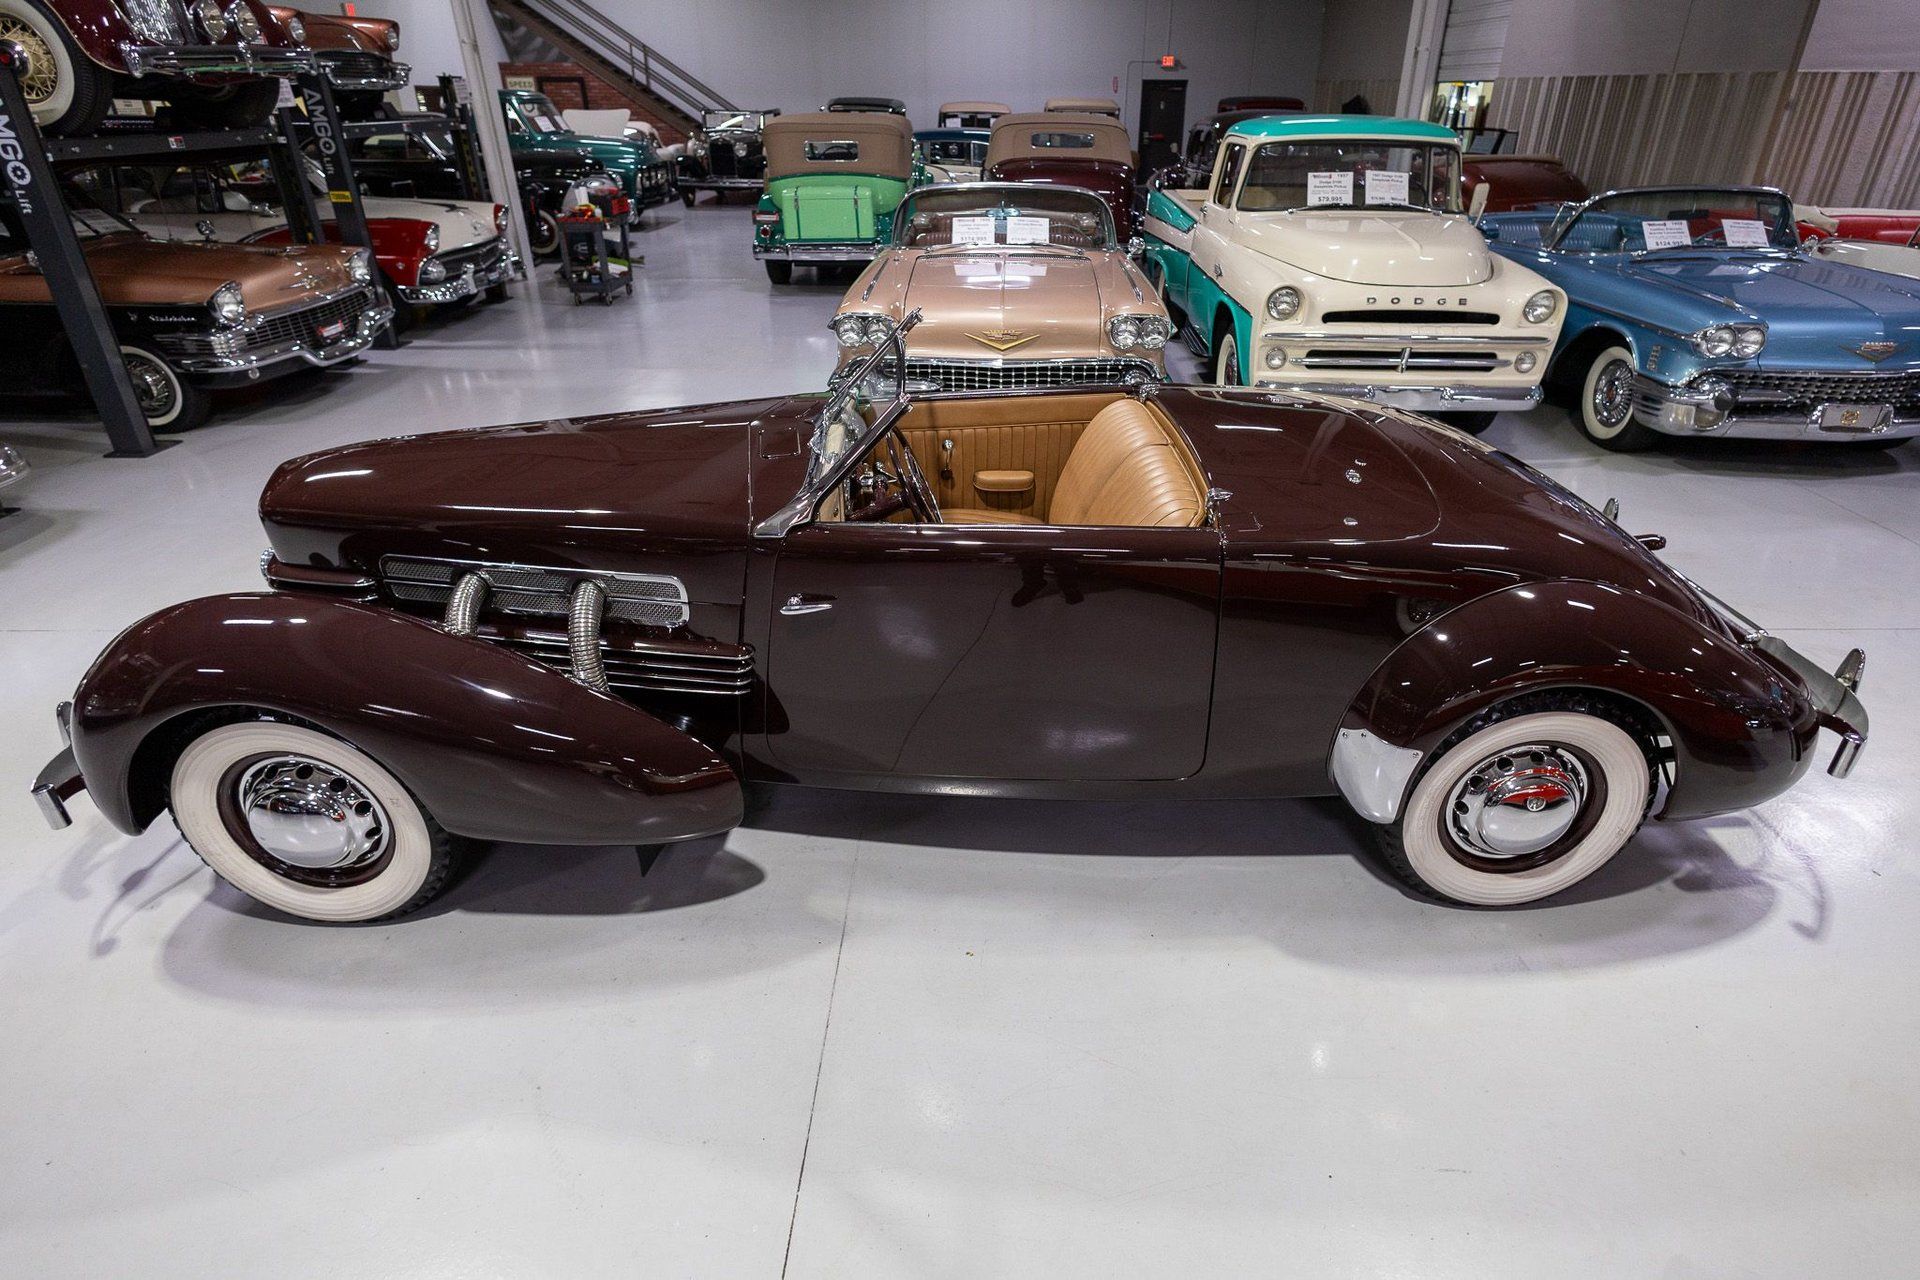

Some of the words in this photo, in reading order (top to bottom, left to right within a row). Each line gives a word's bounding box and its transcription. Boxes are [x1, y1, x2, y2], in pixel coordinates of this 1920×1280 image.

[1161, 55, 1175, 67] EXIT
[303, 86, 336, 155] AMGO
[0, 98, 31, 185] MGO
[1366, 297, 1467, 306] DODGE
